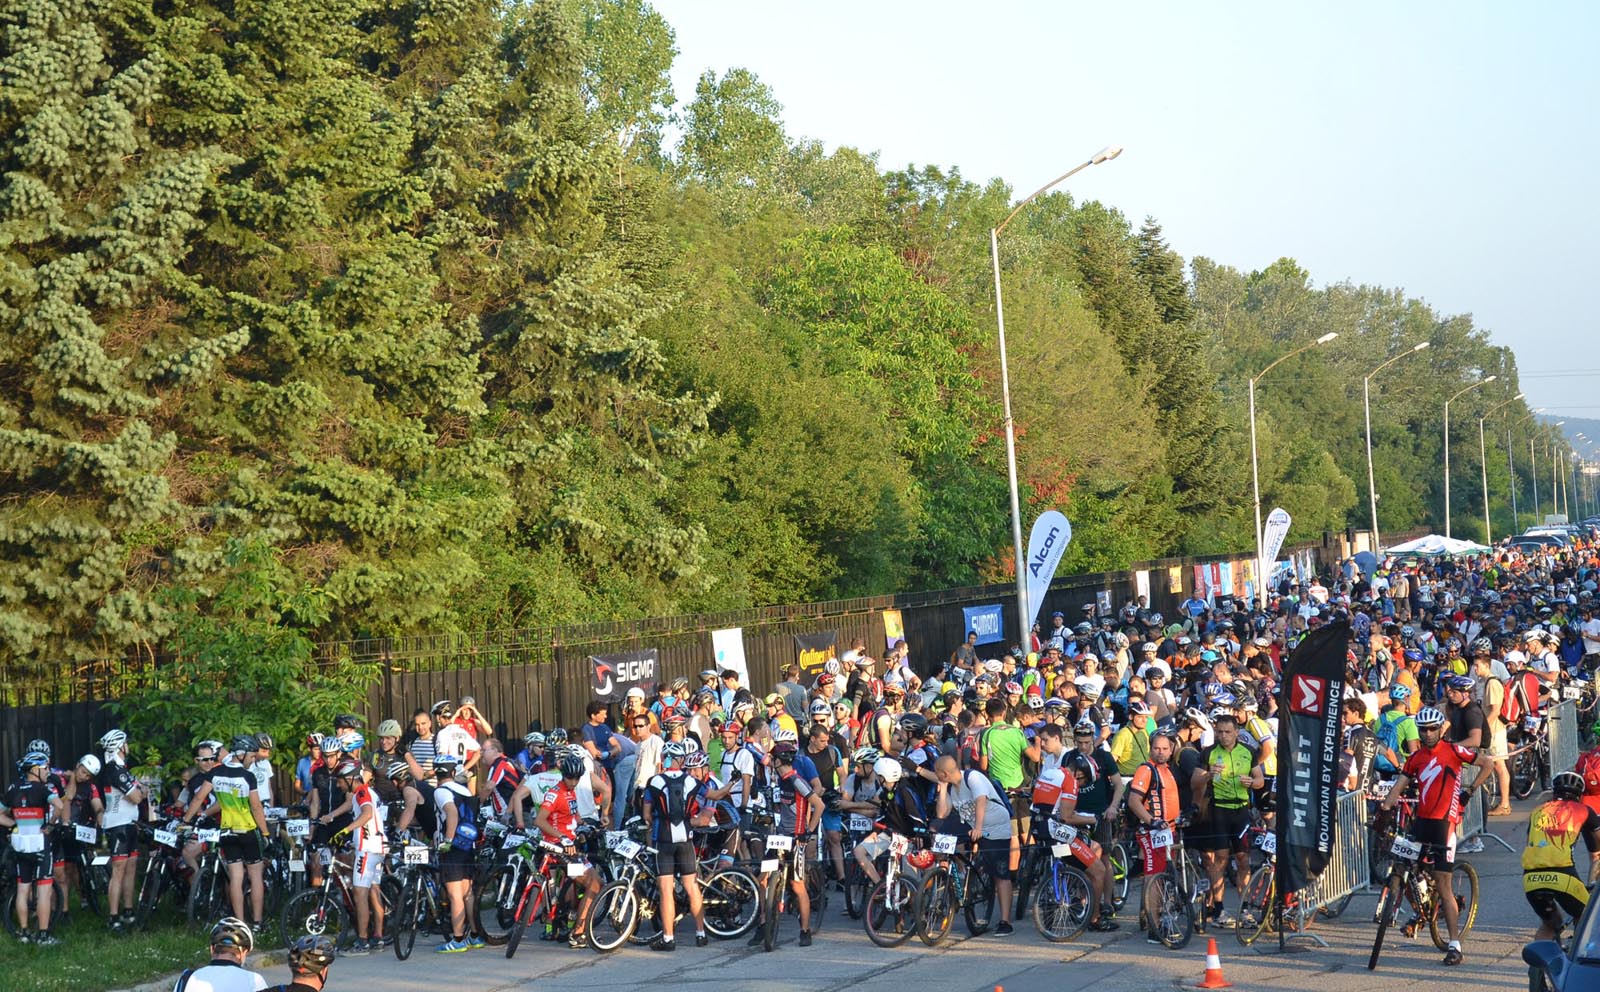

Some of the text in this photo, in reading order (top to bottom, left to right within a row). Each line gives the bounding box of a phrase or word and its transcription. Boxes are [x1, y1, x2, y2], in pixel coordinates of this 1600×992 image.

[1029, 526, 1060, 578] Alcon
[971, 613, 999, 636] SHIMANO
[616, 659, 654, 683] SIGMA
[1318, 680, 1341, 853] MOUNTAIN BY EXPERIENCE
[1293, 735, 1312, 828] MILLET
[287, 825, 304, 834] 620
[851, 820, 867, 828] 586
[1055, 830, 1071, 840] 508
[1394, 844, 1413, 856] 500
[1526, 874, 1559, 883] KENDA
